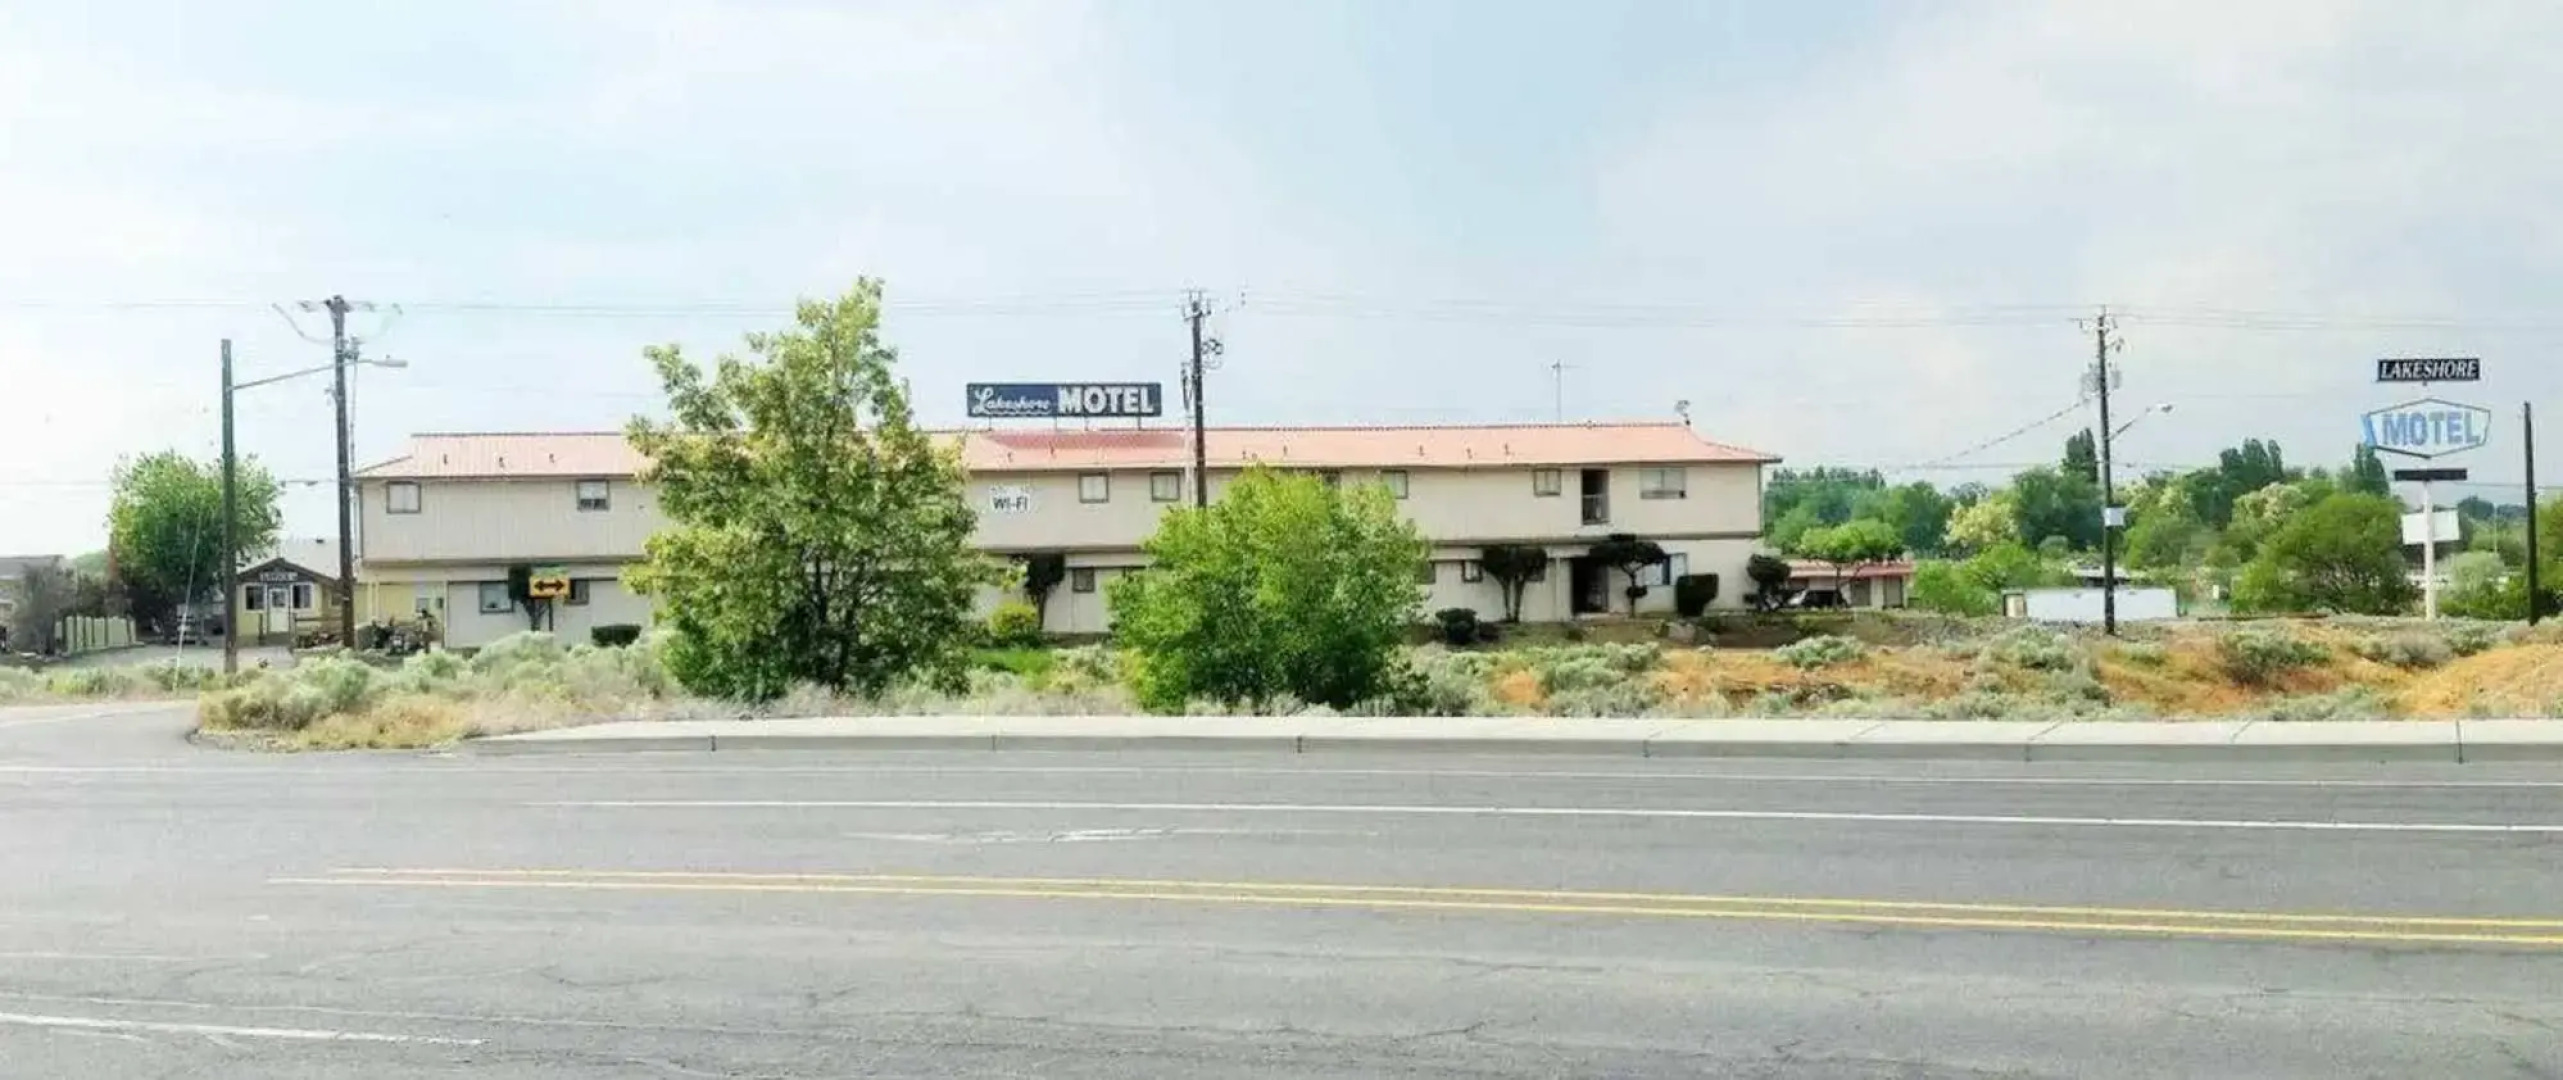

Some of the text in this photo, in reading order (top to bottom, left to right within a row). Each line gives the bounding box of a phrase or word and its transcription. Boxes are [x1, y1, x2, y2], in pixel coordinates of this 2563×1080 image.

[2381, 361, 2478, 379] LAKESHORE
[972, 386, 1154, 414] Lakeshore MOTEL
[2382, 411, 2480, 446] MOTEL
